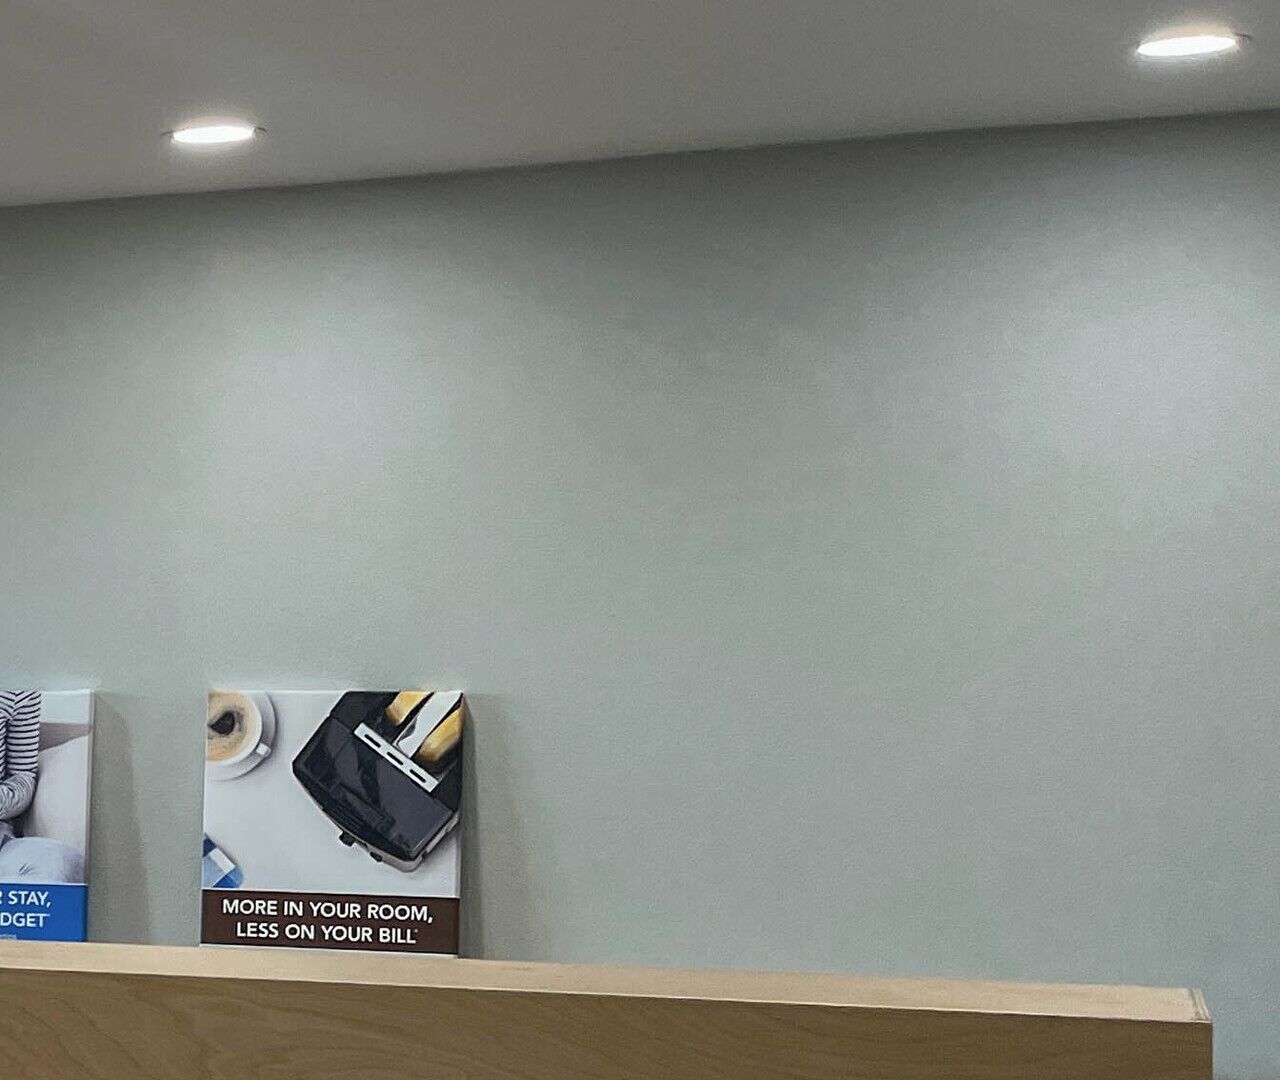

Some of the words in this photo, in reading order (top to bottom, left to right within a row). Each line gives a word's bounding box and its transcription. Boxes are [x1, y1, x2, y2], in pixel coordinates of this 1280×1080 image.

[7, 890, 52, 908] STAY,
[222, 898, 278, 916] MORE
[283, 900, 303, 917] IN
[309, 901, 361, 919] YOUR
[367, 904, 434, 923] ROOM,
[236, 922, 279, 939] LESS
[285, 924, 315, 940] ON
[320, 925, 373, 943] YOUR
